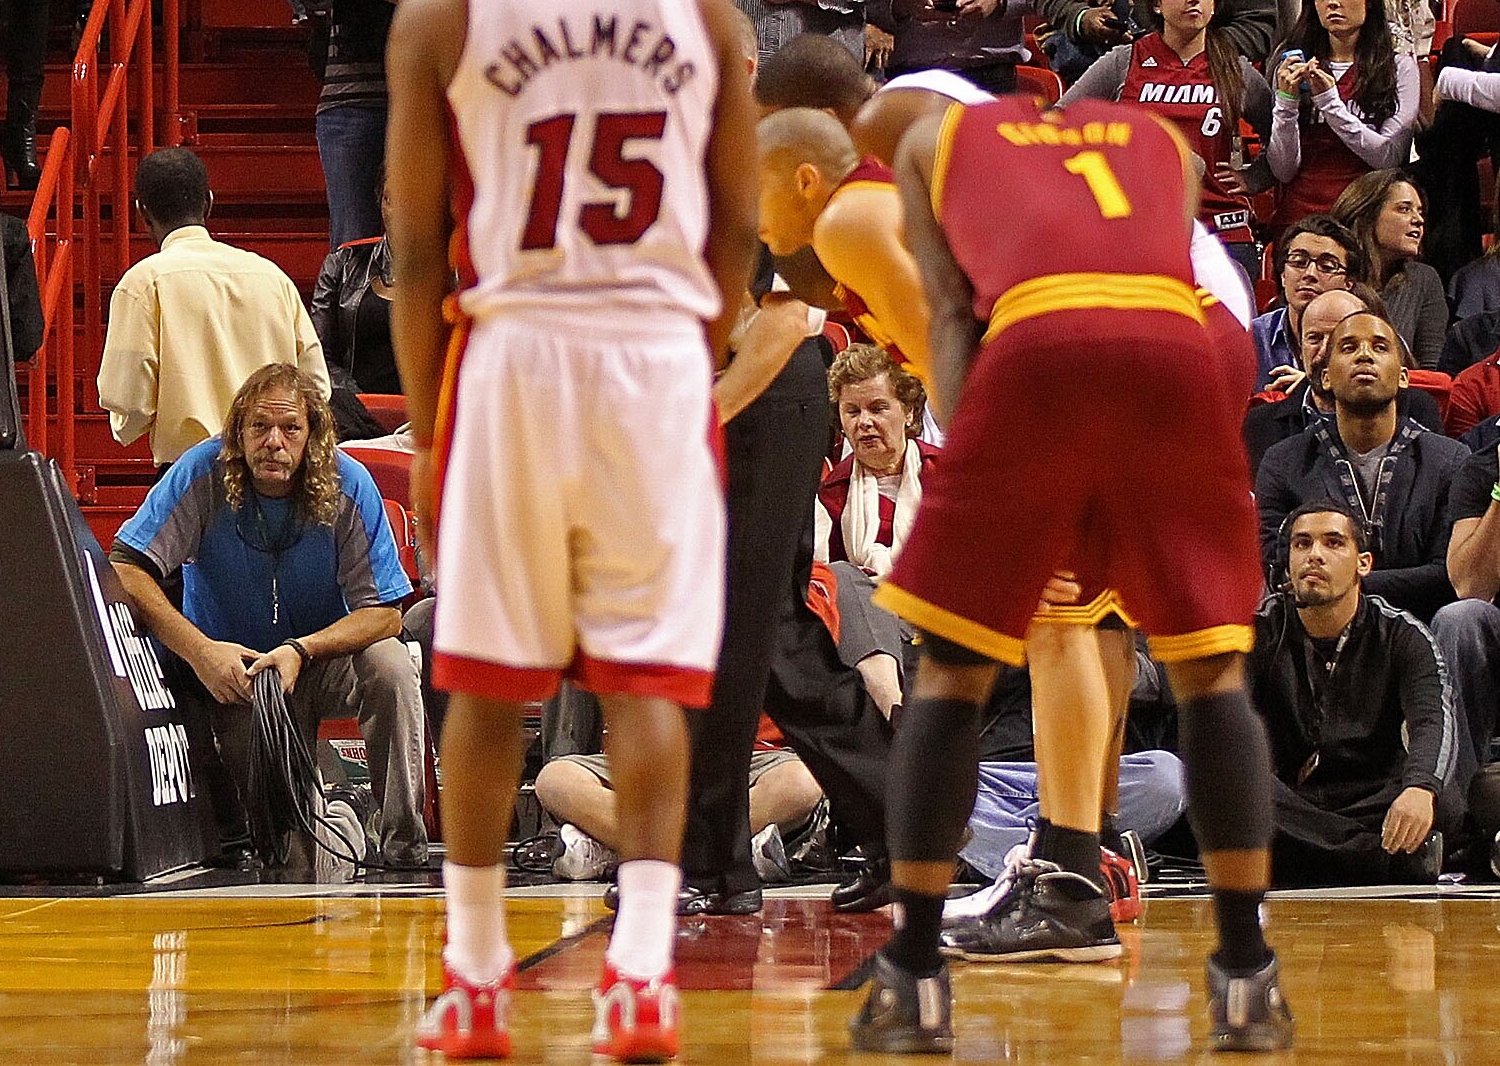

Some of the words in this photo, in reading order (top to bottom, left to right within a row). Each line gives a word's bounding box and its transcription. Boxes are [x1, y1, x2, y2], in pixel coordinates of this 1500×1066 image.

[484, 13, 697, 97] CHALMERS
[1200, 107, 1223, 137] 6
[519, 109, 668, 251] 15
[1062, 149, 1133, 220] 1
[144, 722, 196, 807] DEPOT
